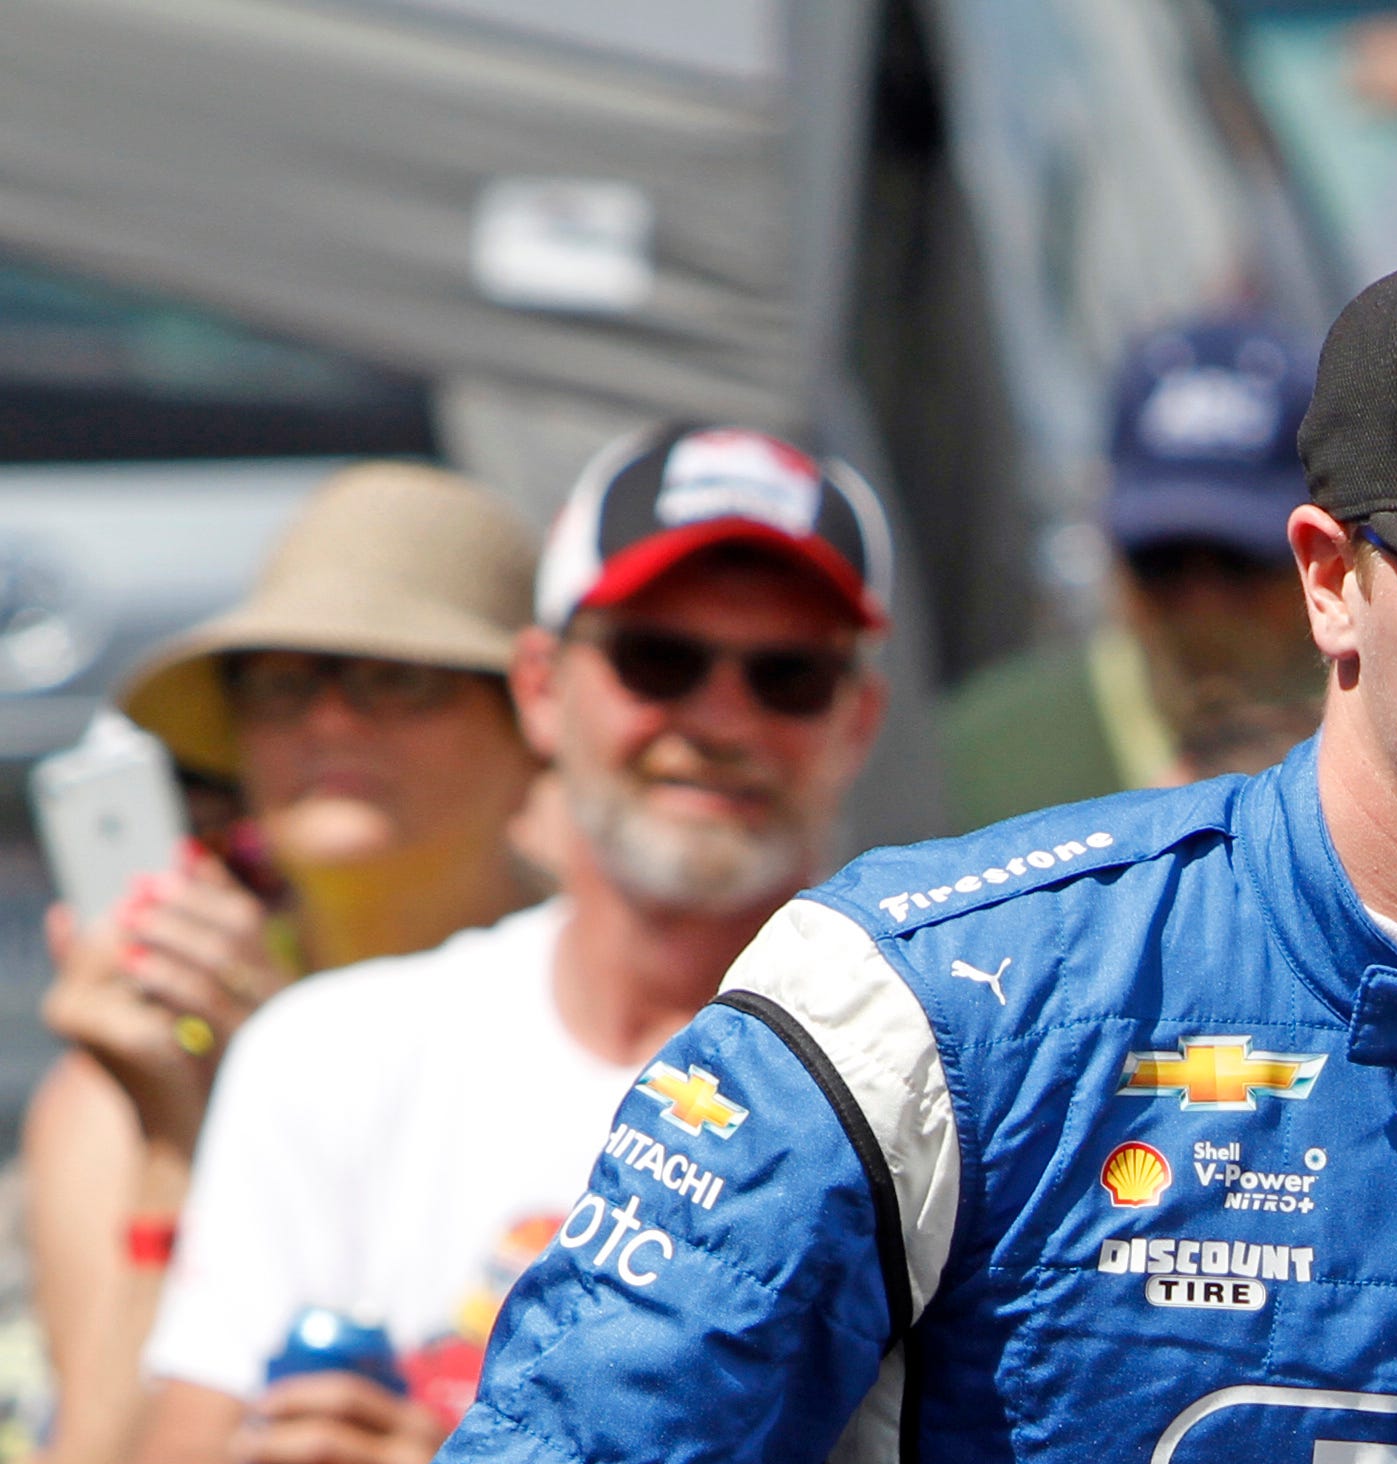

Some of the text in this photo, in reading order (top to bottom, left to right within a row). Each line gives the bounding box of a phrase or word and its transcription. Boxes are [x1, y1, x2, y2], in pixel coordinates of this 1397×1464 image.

[879, 832, 1114, 923] Firestone
[604, 1123, 724, 1210] HITACHI
[1193, 1142, 1240, 1161] Shell
[1193, 1162, 1316, 1193] V-Power
[1098, 1238, 1314, 1283] DISCOUNT
[1157, 1280, 1251, 1305] TIRE
